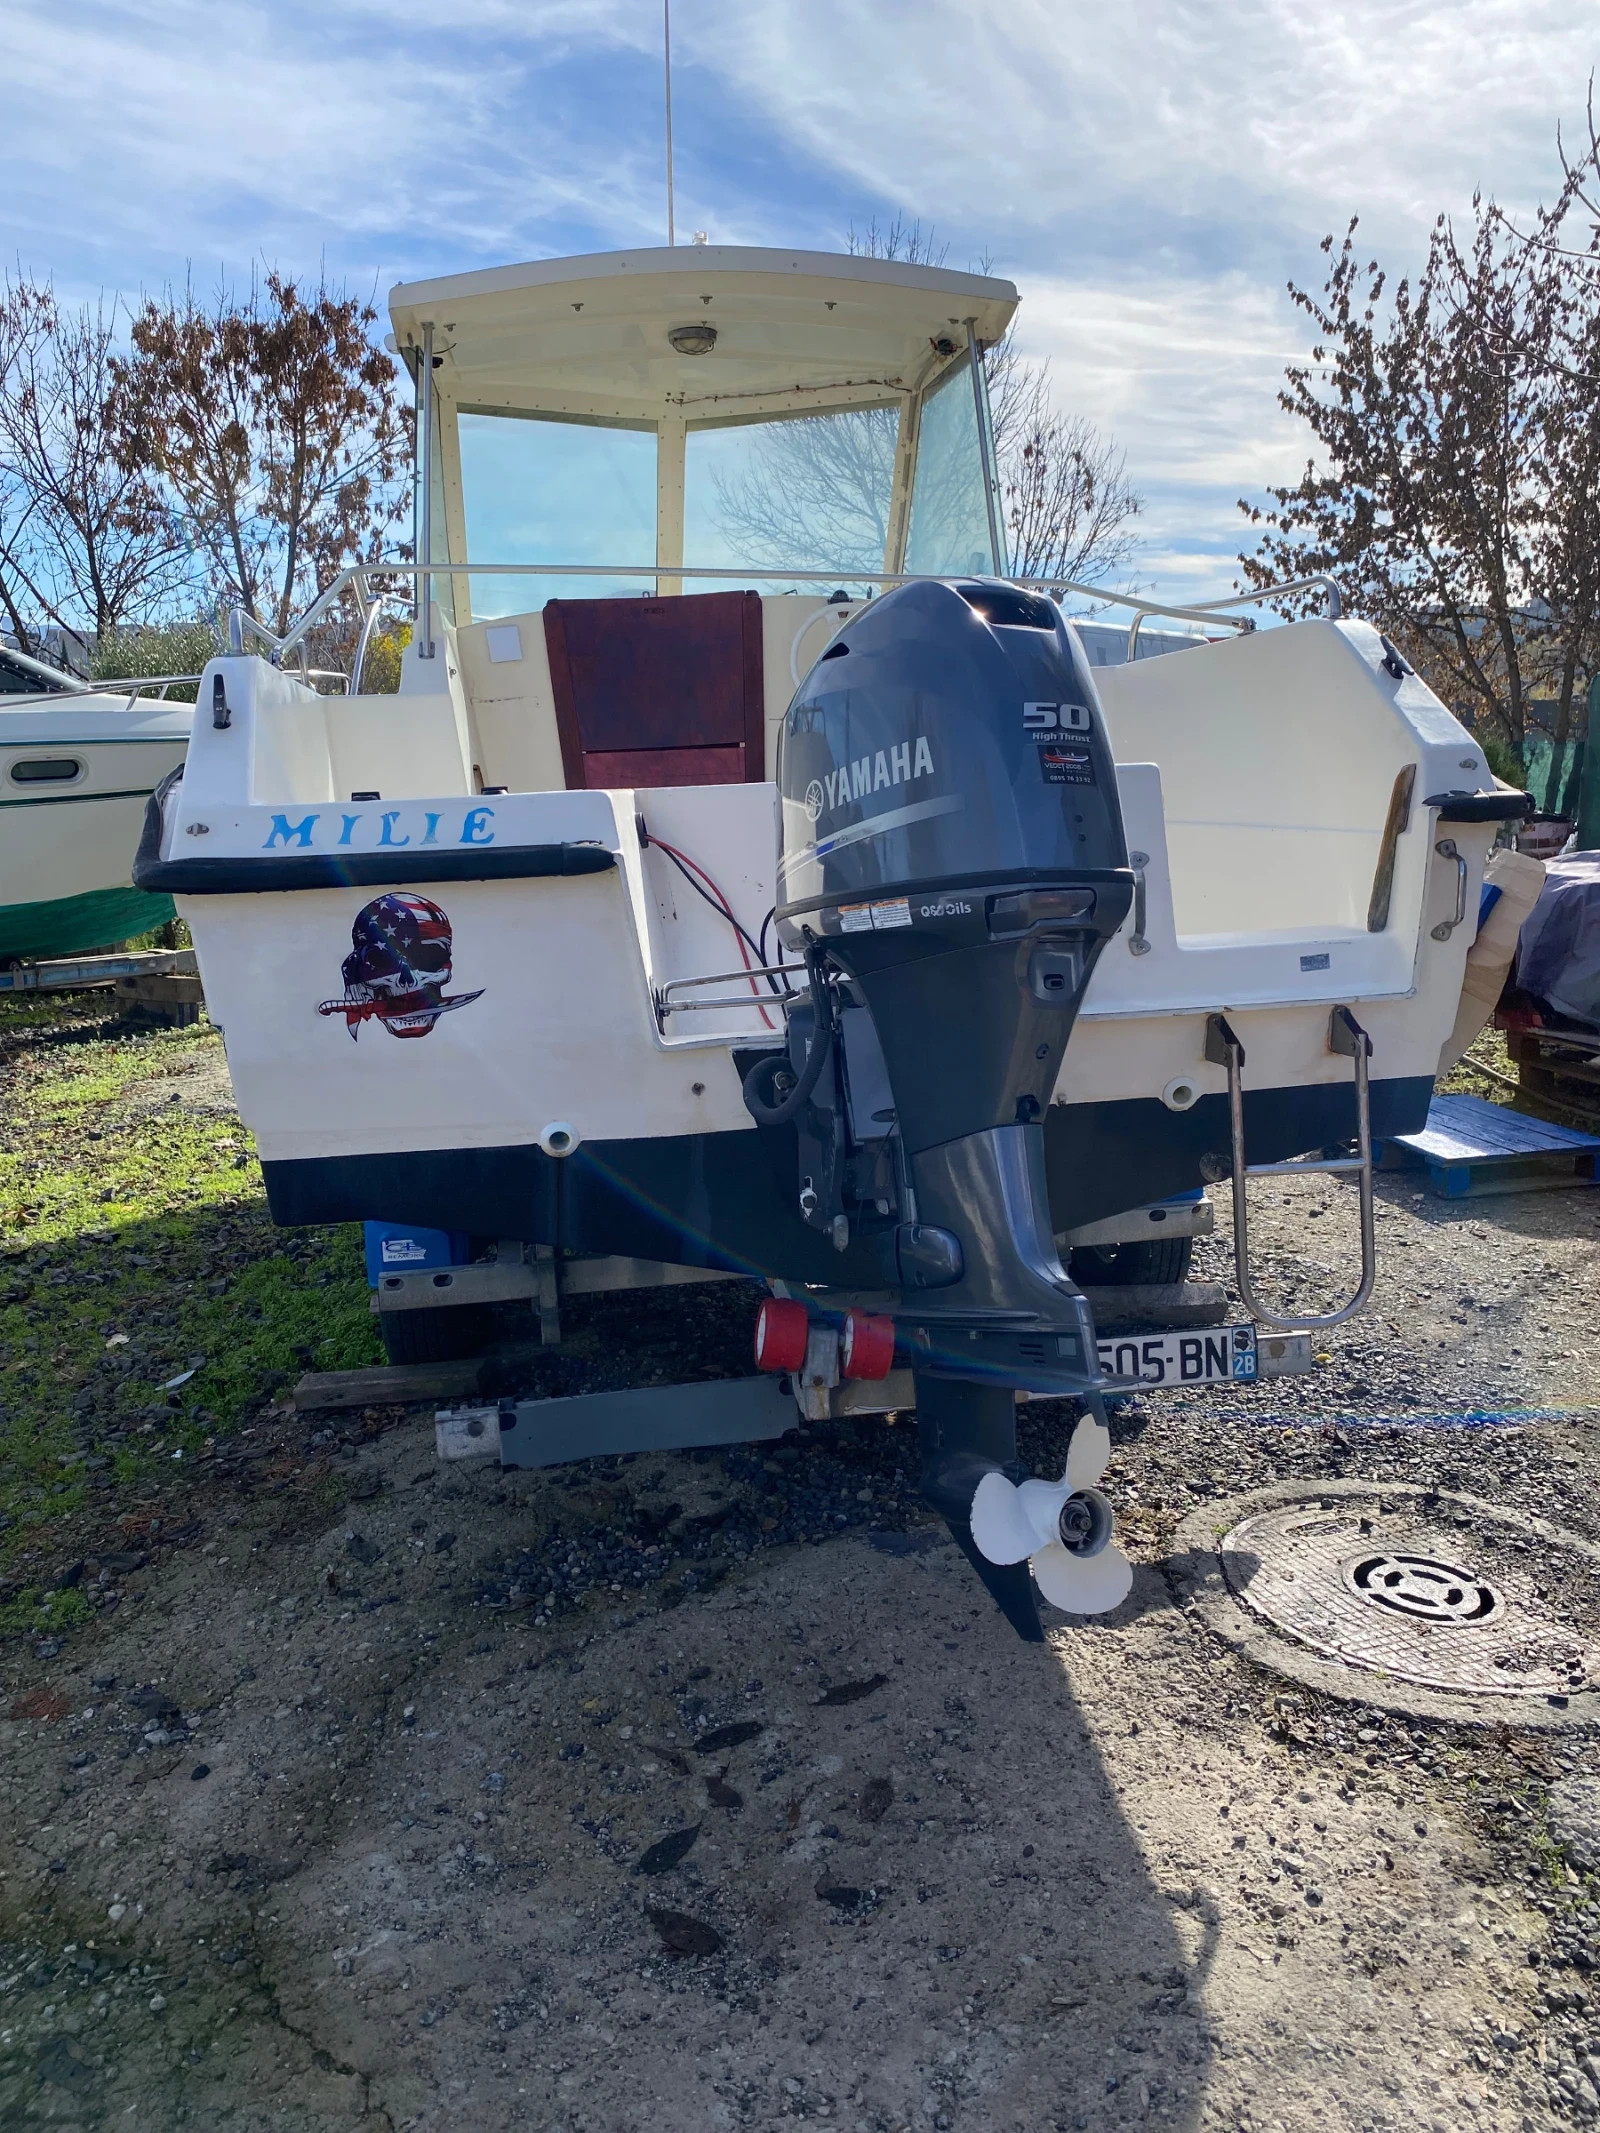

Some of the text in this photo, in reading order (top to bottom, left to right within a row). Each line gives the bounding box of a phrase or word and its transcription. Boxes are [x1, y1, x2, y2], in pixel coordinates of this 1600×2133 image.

[1023, 702, 1091, 731] 50
[1032, 732, 1091, 743] High Thrust
[824, 736, 935, 811] YAMAHA
[1234, 1355, 1255, 1375] 2B
